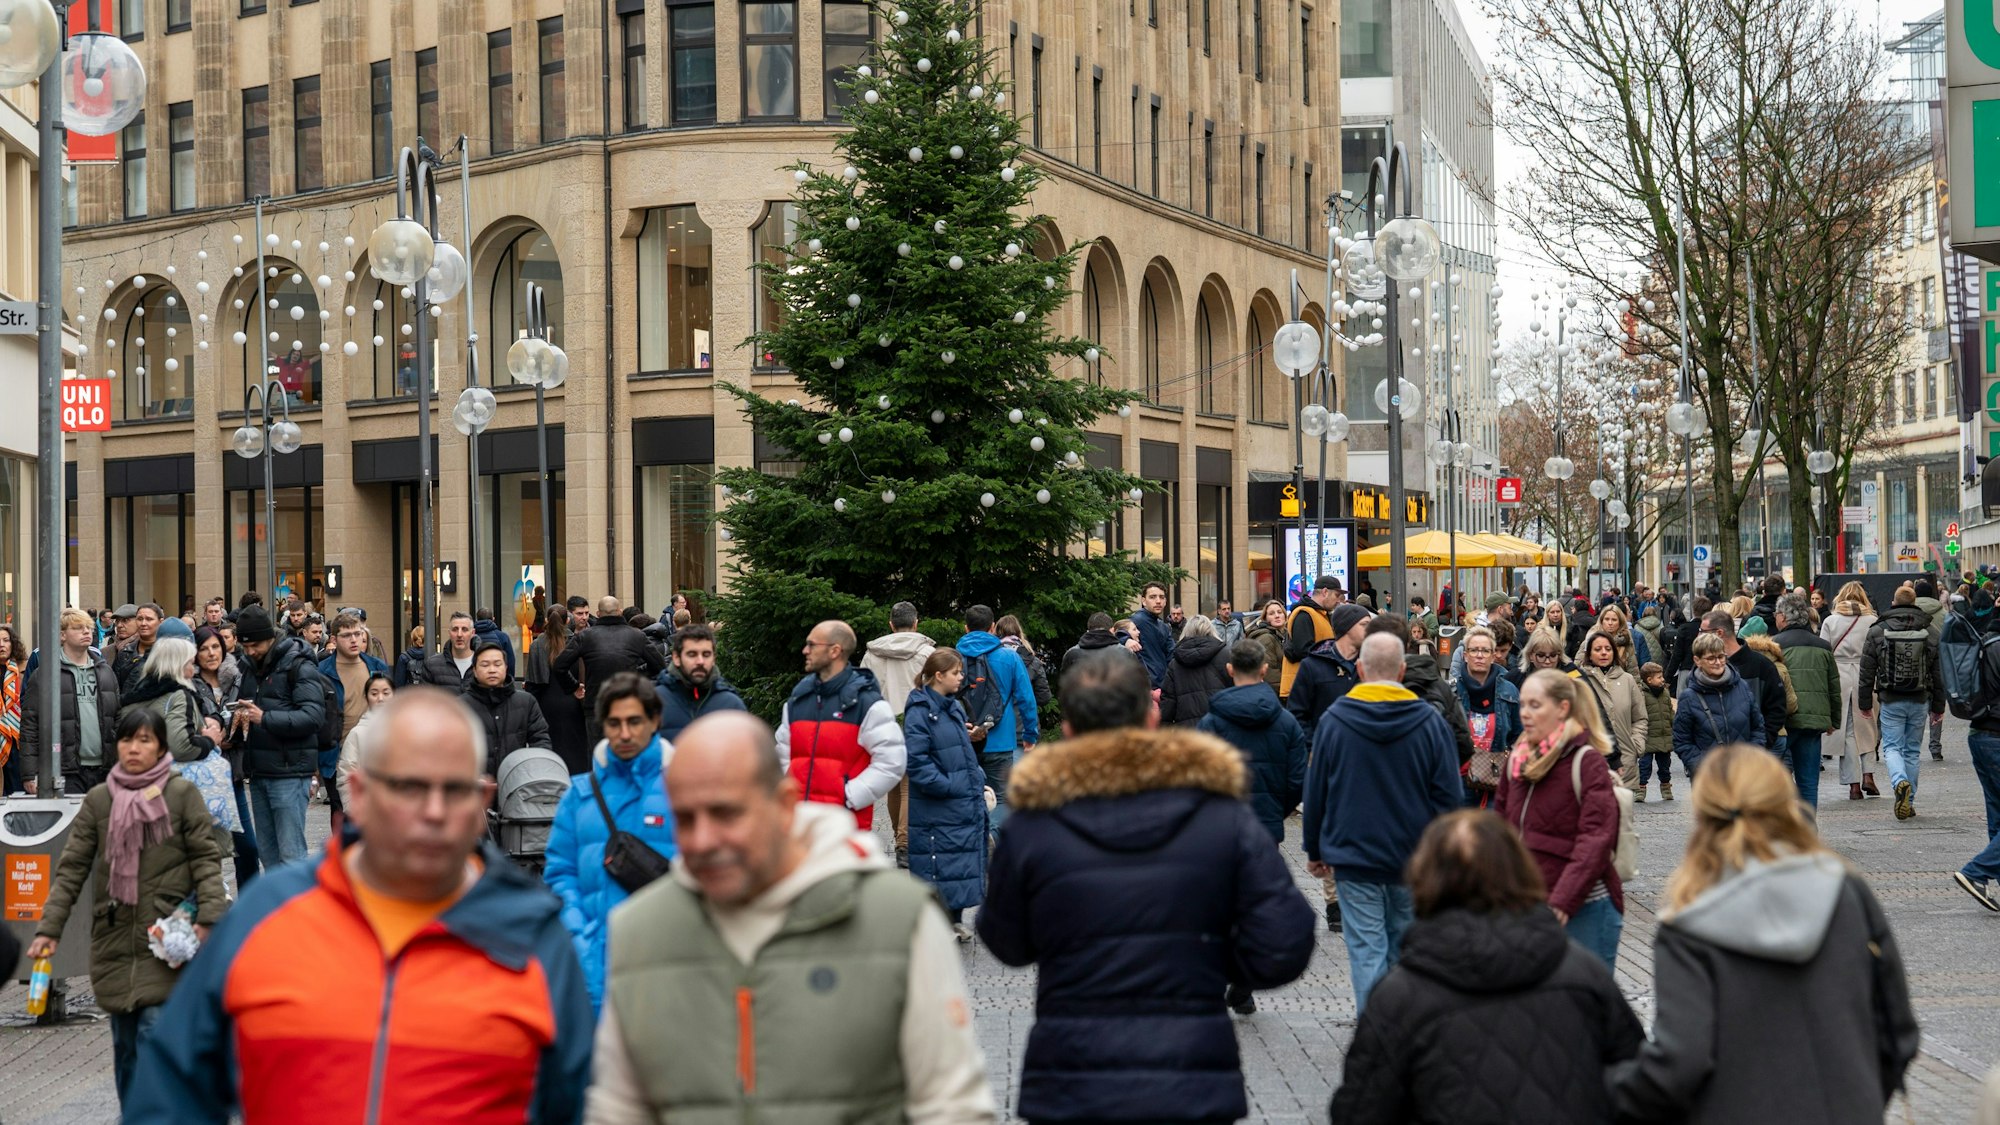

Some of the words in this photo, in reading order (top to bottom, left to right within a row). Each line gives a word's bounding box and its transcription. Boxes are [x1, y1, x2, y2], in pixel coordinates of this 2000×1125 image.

[0, 309, 28, 326] Str.
[63, 386, 101, 404] UNI
[63, 407, 104, 428] QLO
[1901, 545, 1916, 556] dm
[1406, 556, 1442, 564] Merzenich
[1896, 653, 1905, 677] FACE
[1904, 643, 1913, 677] NORTH
[1912, 660, 1920, 677] THE
[16, 861, 25, 870] Ich
[25, 873, 42, 881] einen
[18, 881, 34, 892] Korb!
